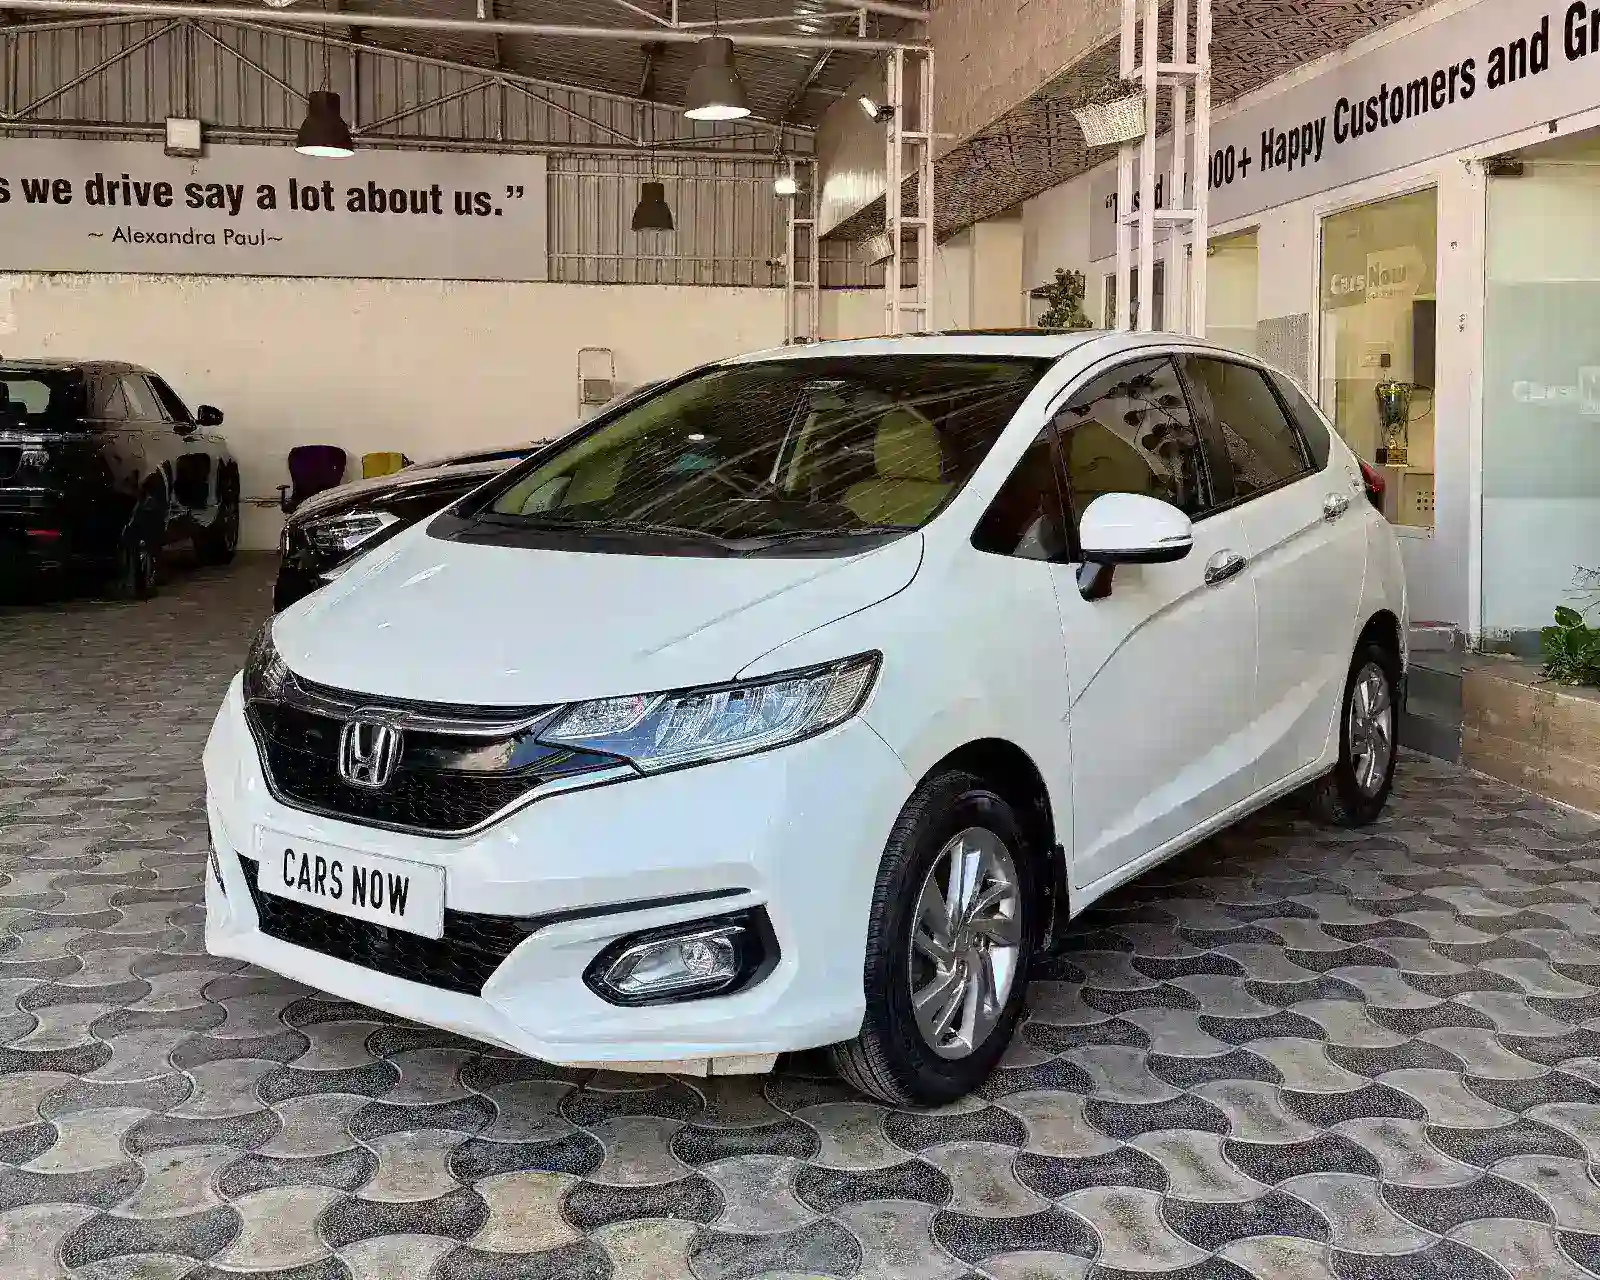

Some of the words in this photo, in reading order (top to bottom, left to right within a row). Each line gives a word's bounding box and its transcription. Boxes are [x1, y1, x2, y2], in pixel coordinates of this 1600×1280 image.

[1260, 117, 1327, 173] Happy
[1333, 57, 1476, 145] Customers
[1486, 15, 1549, 90] and
[20, 178, 73, 205] we
[84, 172, 174, 208] drive
[184, 182, 245, 217] say
[256, 184, 277, 211] a
[287, 176, 336, 212] lot
[346, 180, 444, 216] about
[111, 225, 216, 245] Alexandra
[283, 848, 343, 900] CARS
[351, 865, 410, 917] NOW
